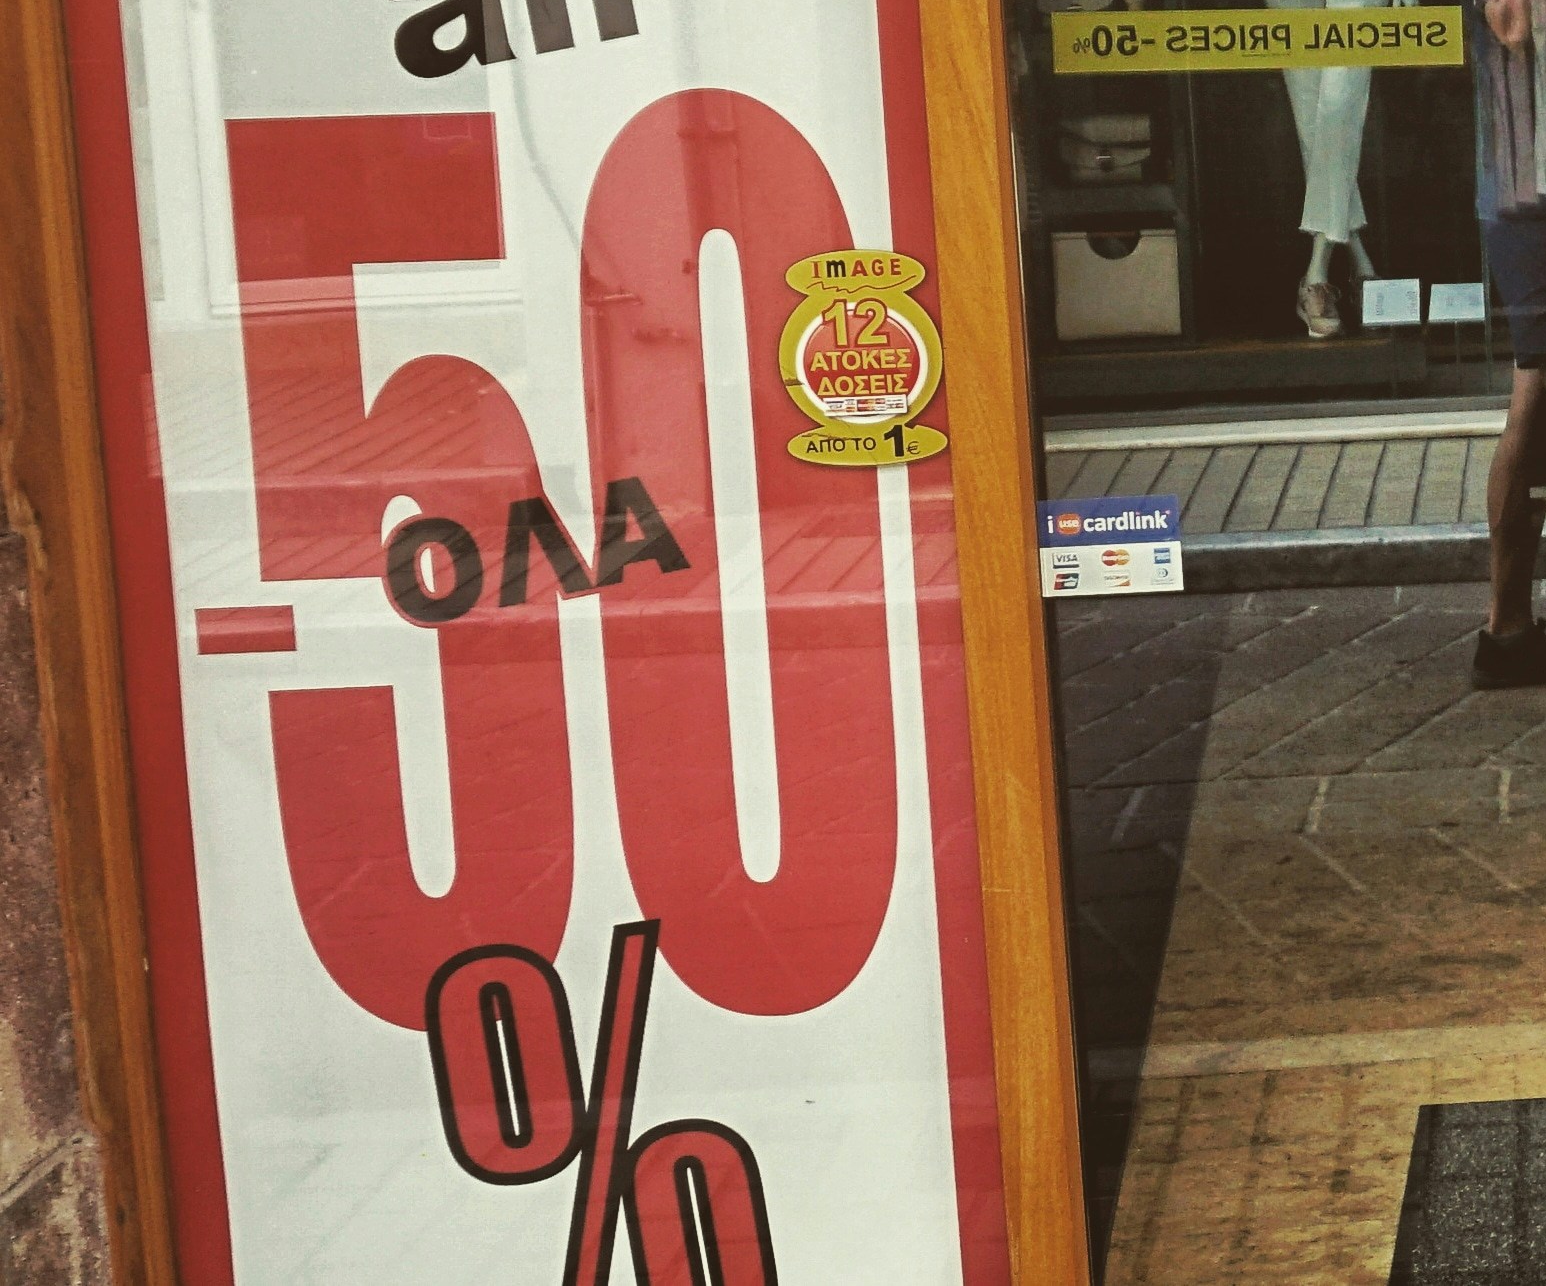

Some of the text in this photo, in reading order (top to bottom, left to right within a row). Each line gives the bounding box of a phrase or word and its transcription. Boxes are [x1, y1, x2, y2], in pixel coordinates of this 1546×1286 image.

[821, 297, 890, 348] 12
[810, 348, 912, 372] ΑΤΟΚΕΣ
[817, 373, 909, 396] ΔΟΣΕΙΣ
[806, 437, 846, 454] ΑΠΟ
[852, 436, 877, 452] ΤΟ
[1047, 510, 1168, 534] i use cardlink
[382, 474, 692, 627] ΟΛΑ
